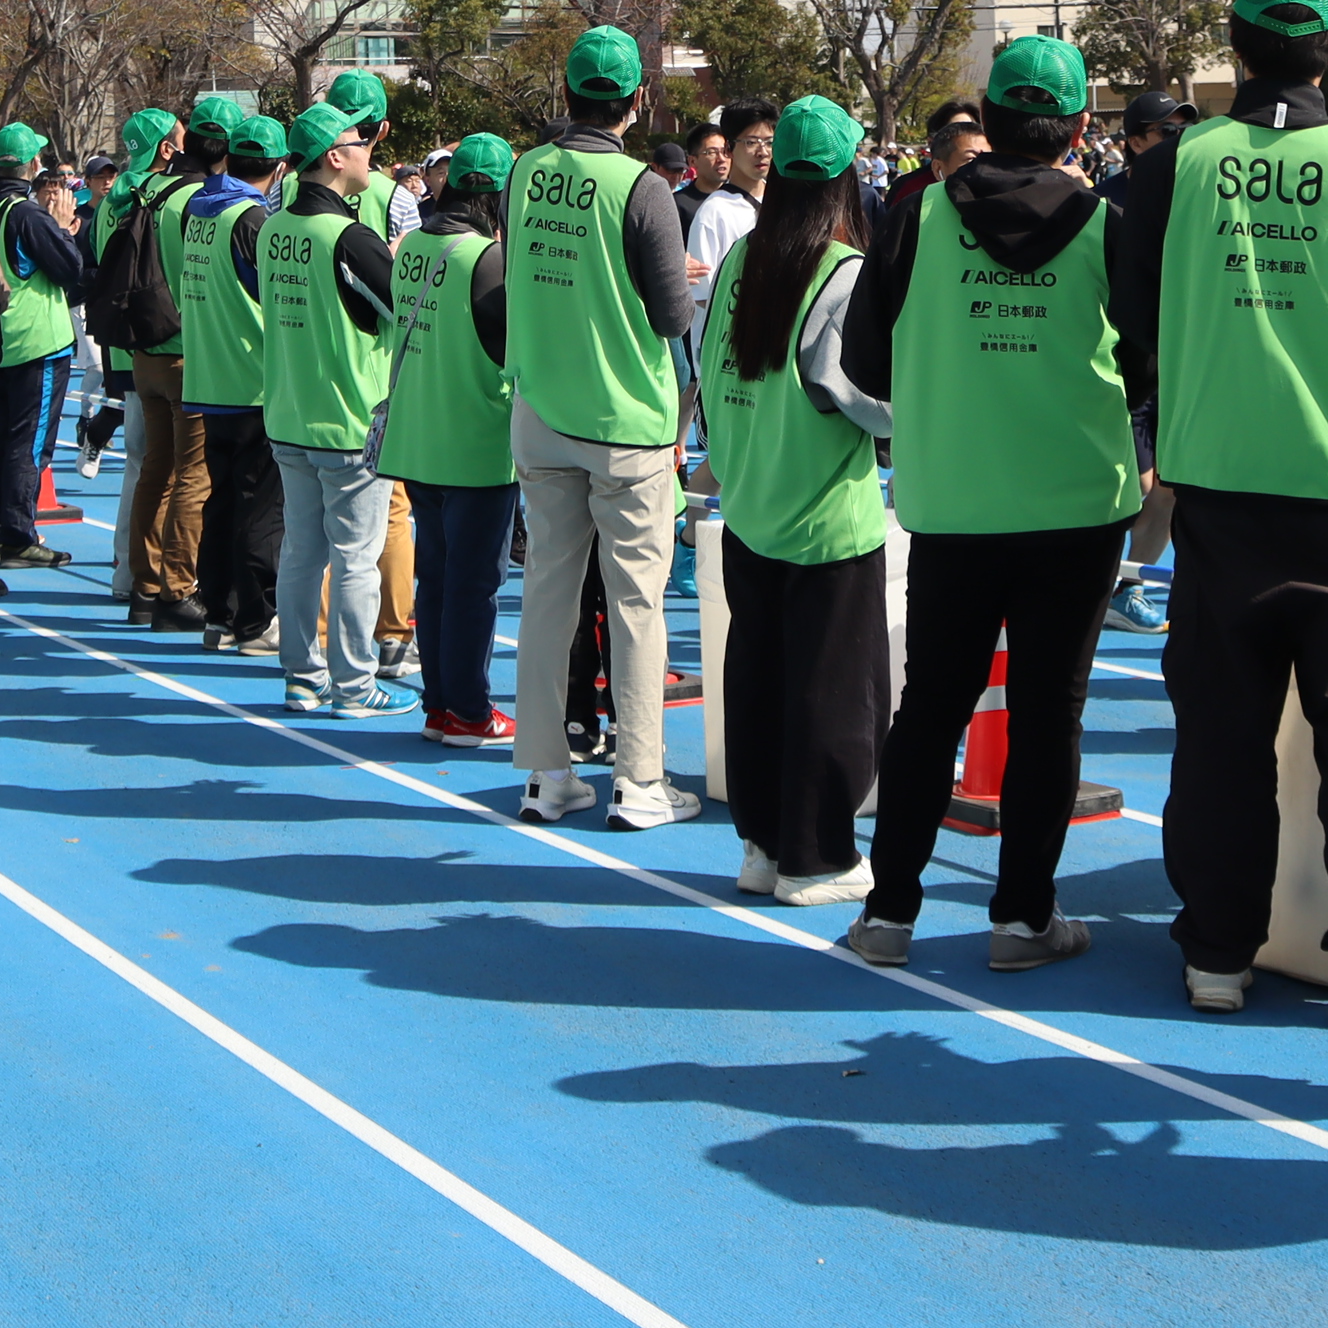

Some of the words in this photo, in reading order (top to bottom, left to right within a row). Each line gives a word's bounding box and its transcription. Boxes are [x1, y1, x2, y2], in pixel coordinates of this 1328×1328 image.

[527, 169, 597, 210] sala
[1217, 155, 1323, 206] sala
[186, 219, 216, 246] sala
[536, 220, 588, 238] AICELLO
[1231, 222, 1317, 242] AICELLO
[268, 233, 312, 265] sala
[399, 252, 447, 287] sala
[1255, 258, 1307, 275] 日本郵政
[974, 270, 1057, 287] AICELLO
[401, 294, 438, 311] AICLLO
[998, 304, 1047, 319] 日本郵政
[1234, 297, 1295, 311] 豊橋信用金庫
[979, 341, 1038, 353] 豊橋信用金庫
